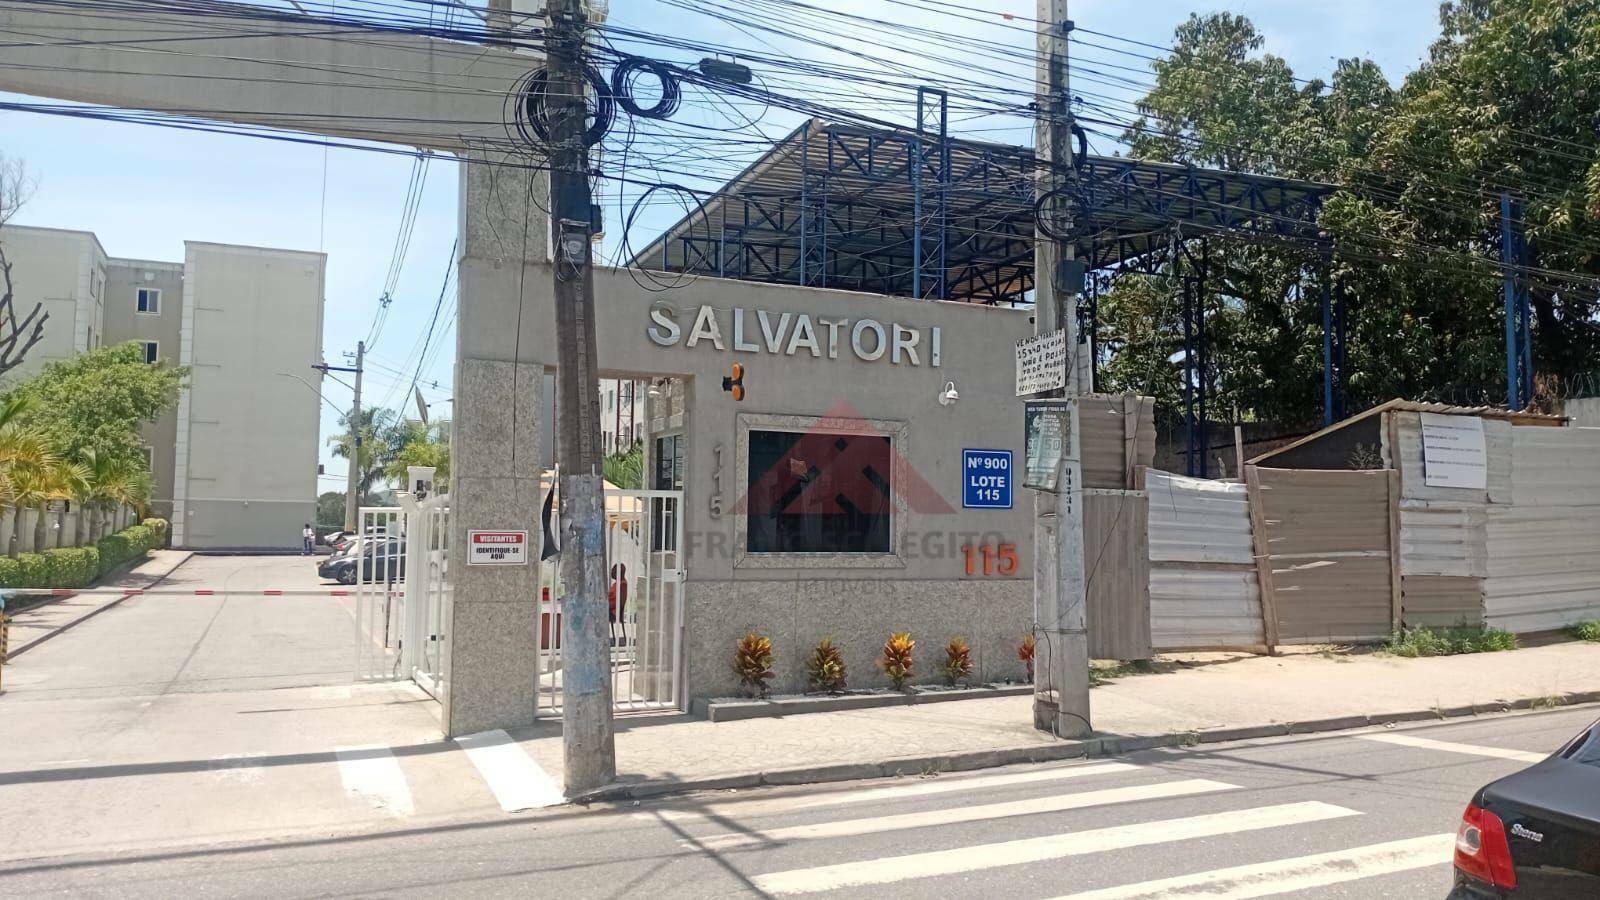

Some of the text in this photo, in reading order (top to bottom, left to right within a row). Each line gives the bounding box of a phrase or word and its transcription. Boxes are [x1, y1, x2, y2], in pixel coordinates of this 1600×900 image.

[647, 300, 941, 367] SALVATORI
[984, 457, 1008, 470] 900
[971, 475, 1005, 488] LOTE
[976, 488, 1000, 501] 115
[480, 535, 518, 543] VISITANTES
[961, 543, 1019, 576] 115
